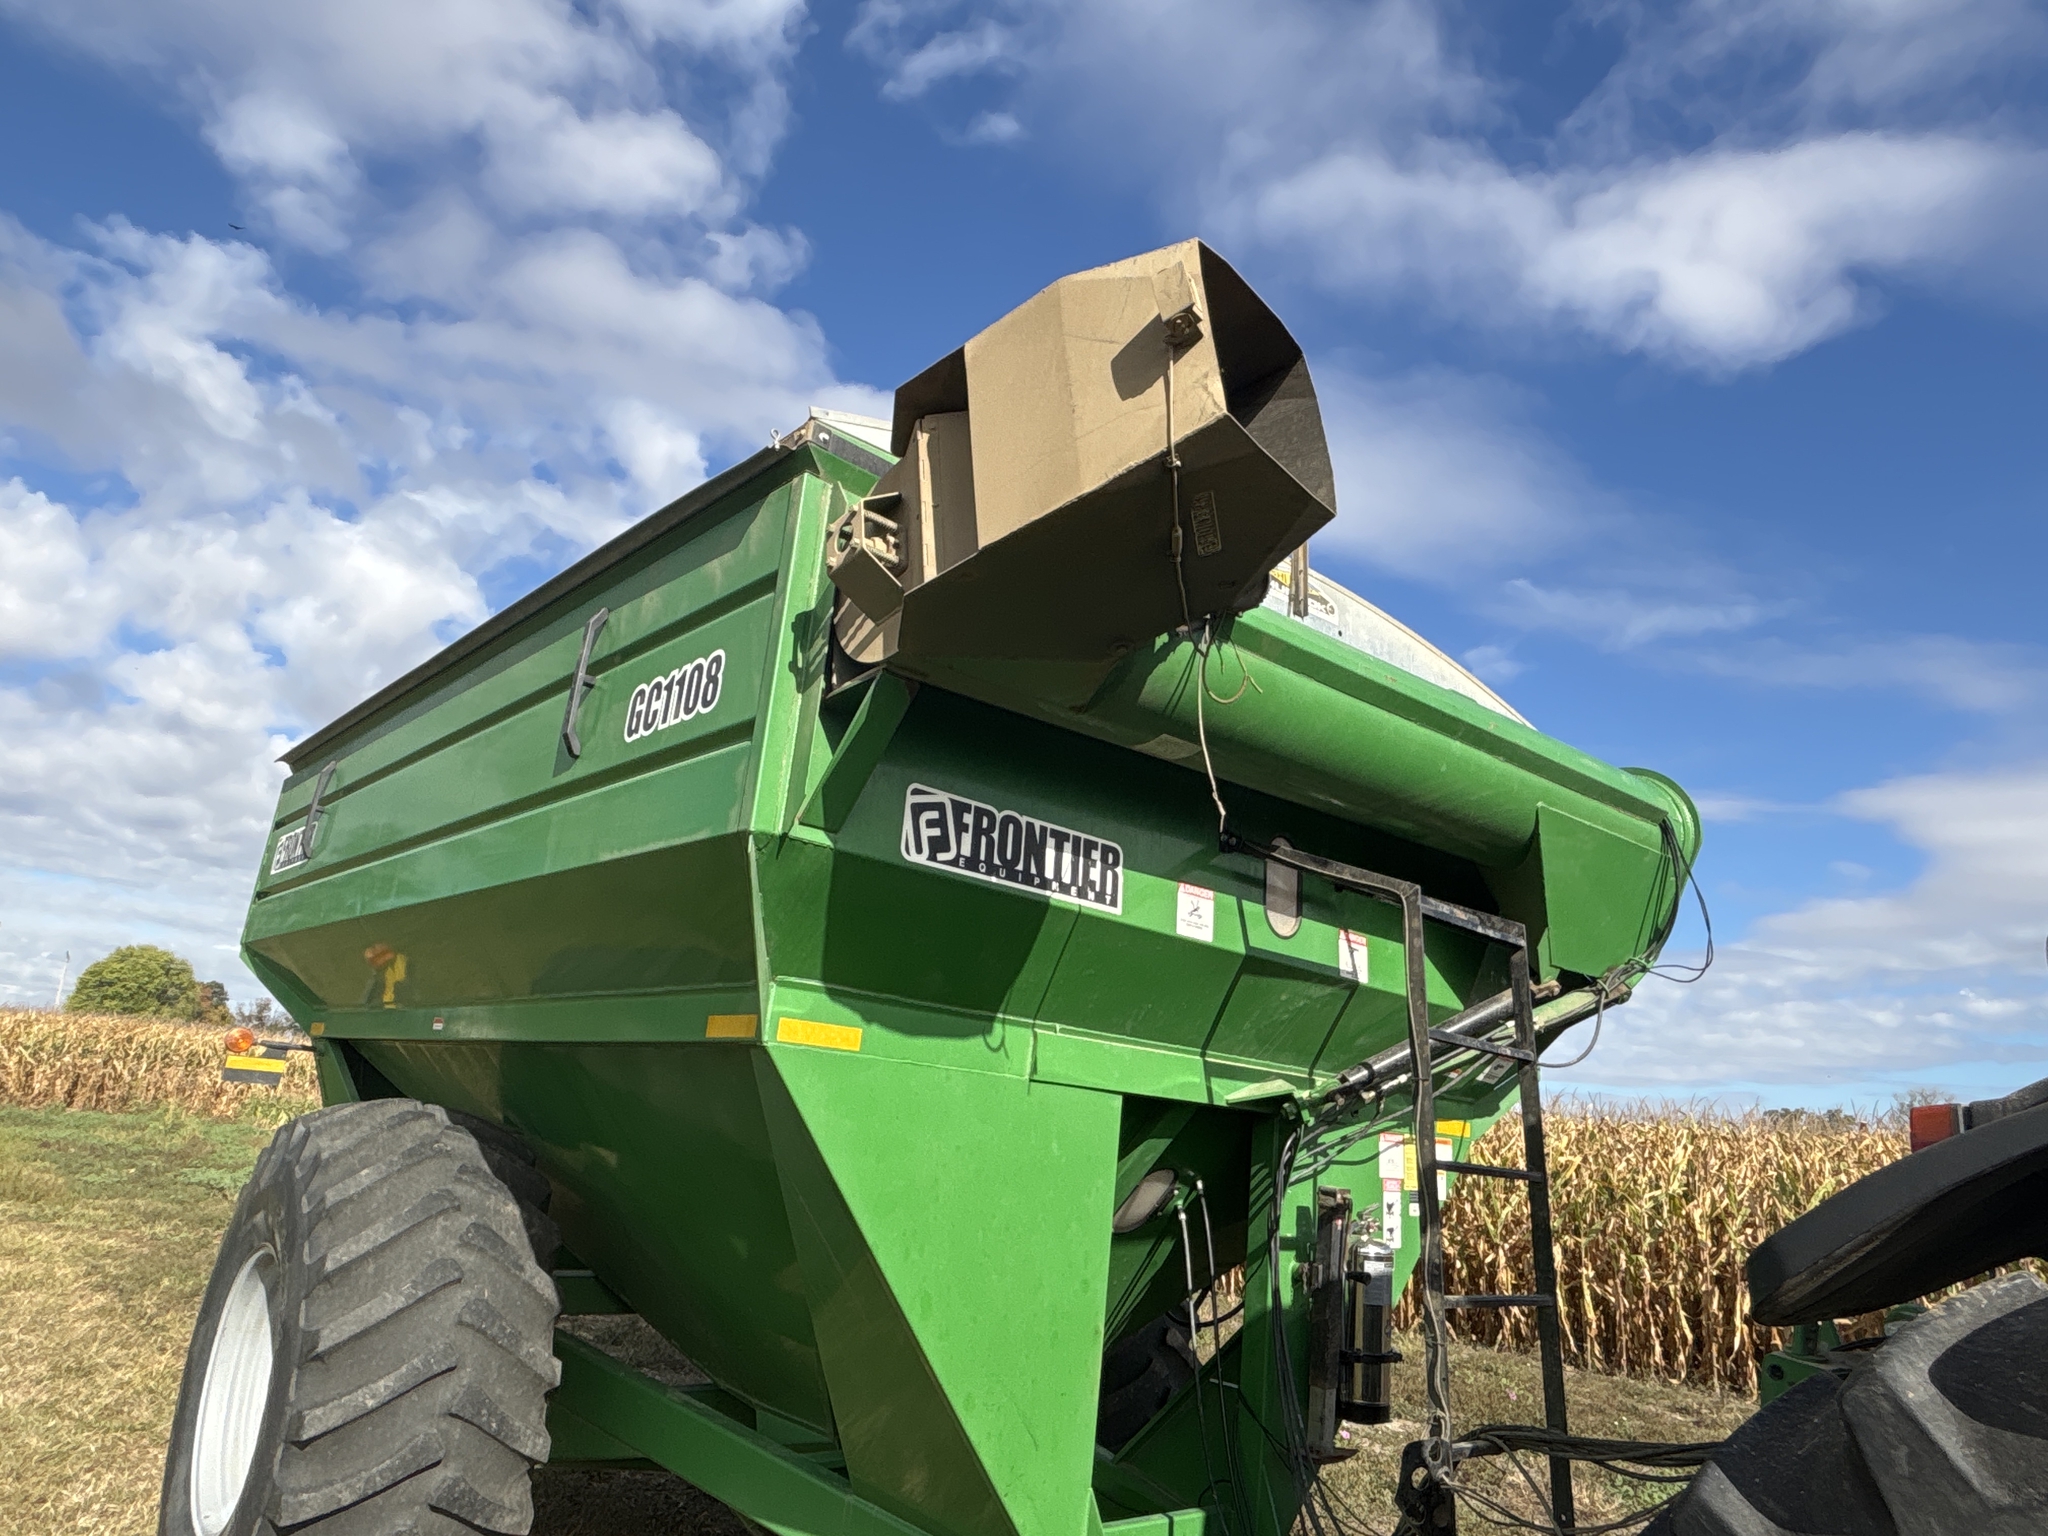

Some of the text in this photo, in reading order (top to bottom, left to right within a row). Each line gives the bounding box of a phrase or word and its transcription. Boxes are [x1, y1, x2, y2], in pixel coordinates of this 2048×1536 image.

[625, 653, 723, 738] GC1108
[949, 798, 1119, 896] FRONTIER
[958, 857, 1112, 905] EQUIPMENT
